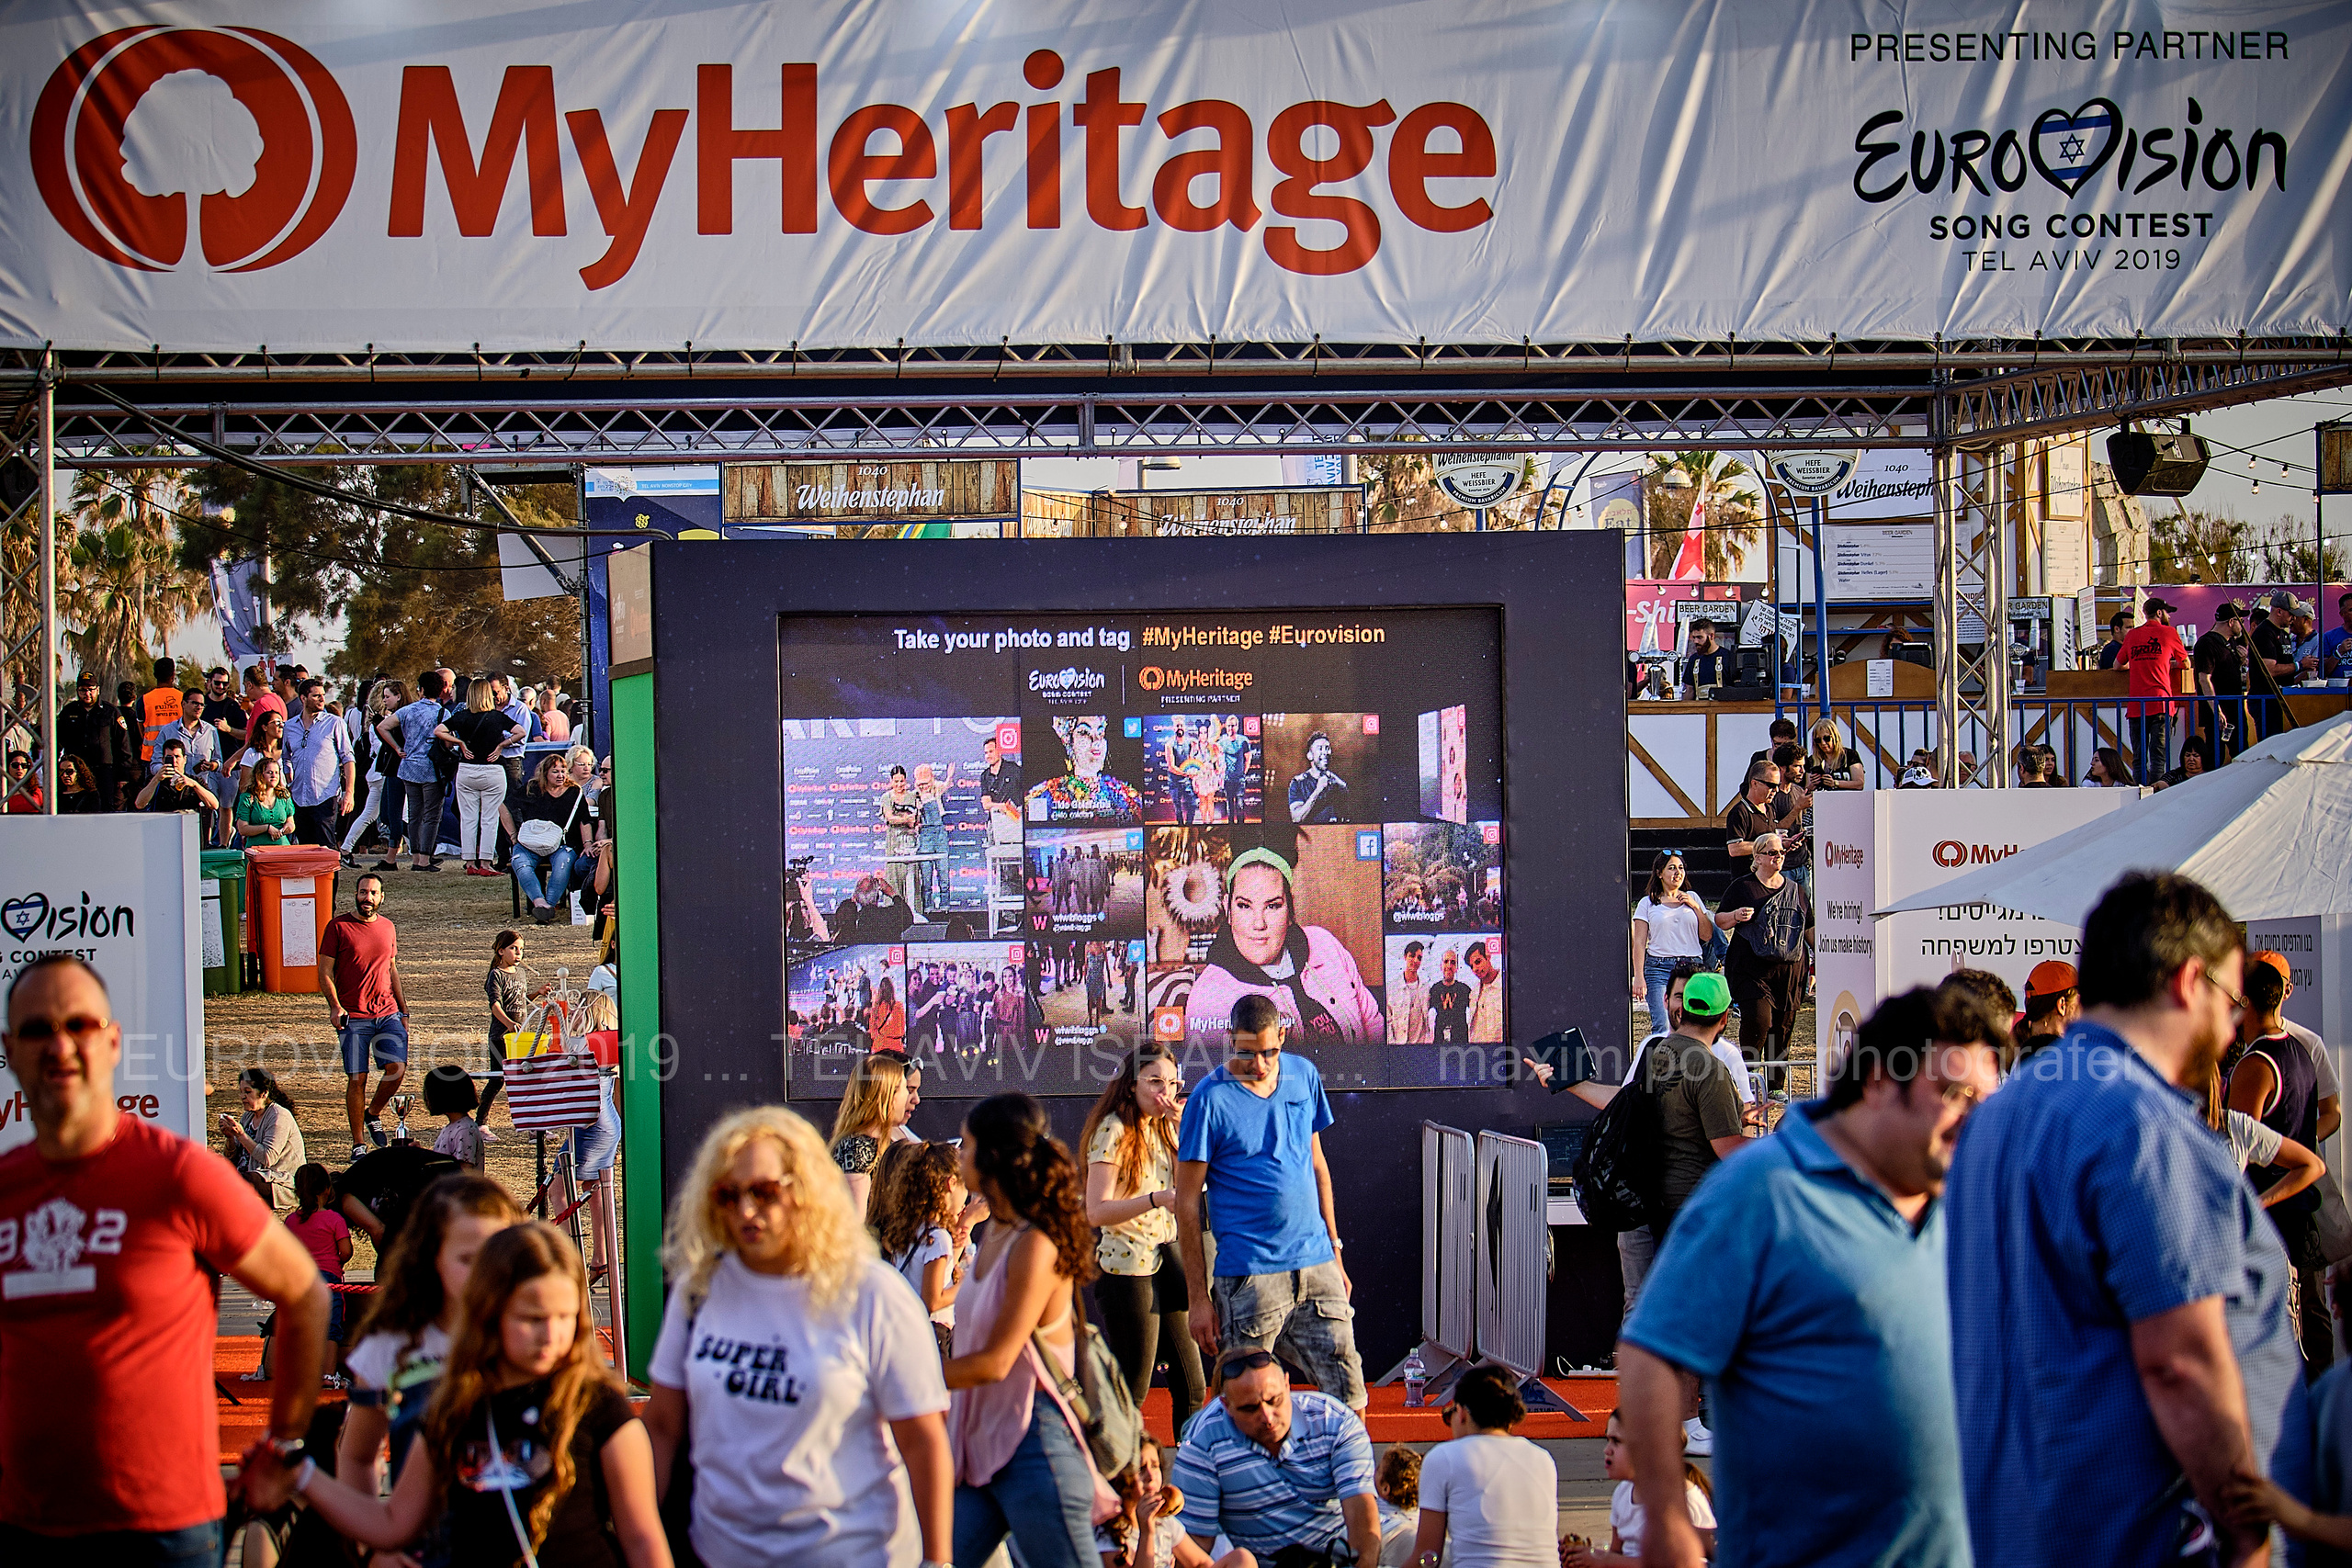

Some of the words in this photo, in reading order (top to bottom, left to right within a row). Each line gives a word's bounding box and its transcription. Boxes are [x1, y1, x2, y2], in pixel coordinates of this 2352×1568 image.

[1850, 31, 2097, 62] PRESENTING
[2113, 30, 2289, 61] PARTNER
[388, 49, 1498, 291] MyHeritage
[1929, 213, 2030, 241] SONG
[2047, 212, 2213, 239] CONTEST
[1962, 250, 2016, 272] TEL
[2030, 249, 2101, 272] AVIV
[2114, 249, 2181, 271] 2019
[857, 465, 888, 478] 1040
[1883, 463, 1909, 473] 1040
[1452, 490, 1476, 503] PREMIUM
[1477, 486, 1507, 503] BAVARICUM
[1462, 479, 1497, 487] WEISSBIER
[1786, 476, 1810, 491] PREMIUM
[1811, 475, 1841, 491] BAVARICUM
[1837, 477, 1934, 500] Weihensteph
[796, 482, 944, 511] Weihenstephan
[1216, 497, 1244, 508] 1040
[1605, 517, 1632, 528] Eat
[1679, 604, 1700, 613] BEER
[1702, 604, 1736, 613] GARDEN
[2015, 601, 2048, 610] GARDEN
[894, 628, 940, 649] Take
[944, 630, 990, 653] your
[994, 627, 1052, 653] photo
[1057, 627, 1094, 649] and
[1098, 627, 1131, 651] tag
[1142, 626, 1264, 650] #MyHeritage
[1269, 624, 1385, 647] #Eurovision
[1166, 668, 1253, 692] MyHeritage
[1834, 843, 1864, 870] MyHeritage
[1826, 900, 1843, 919] We're
[1844, 900, 1863, 924] hiring!
[1818, 933, 1830, 953] Join
[1830, 939, 1838, 953] us
[1838, 934, 1853, 953] make
[1921, 933, 2017, 955] למשפחה
[2024, 938, 2083, 955] צטרפו
[88, 1208, 127, 1255] 2
[695, 1335, 788, 1372] SUPER
[726, 1369, 799, 1405] GIRL
